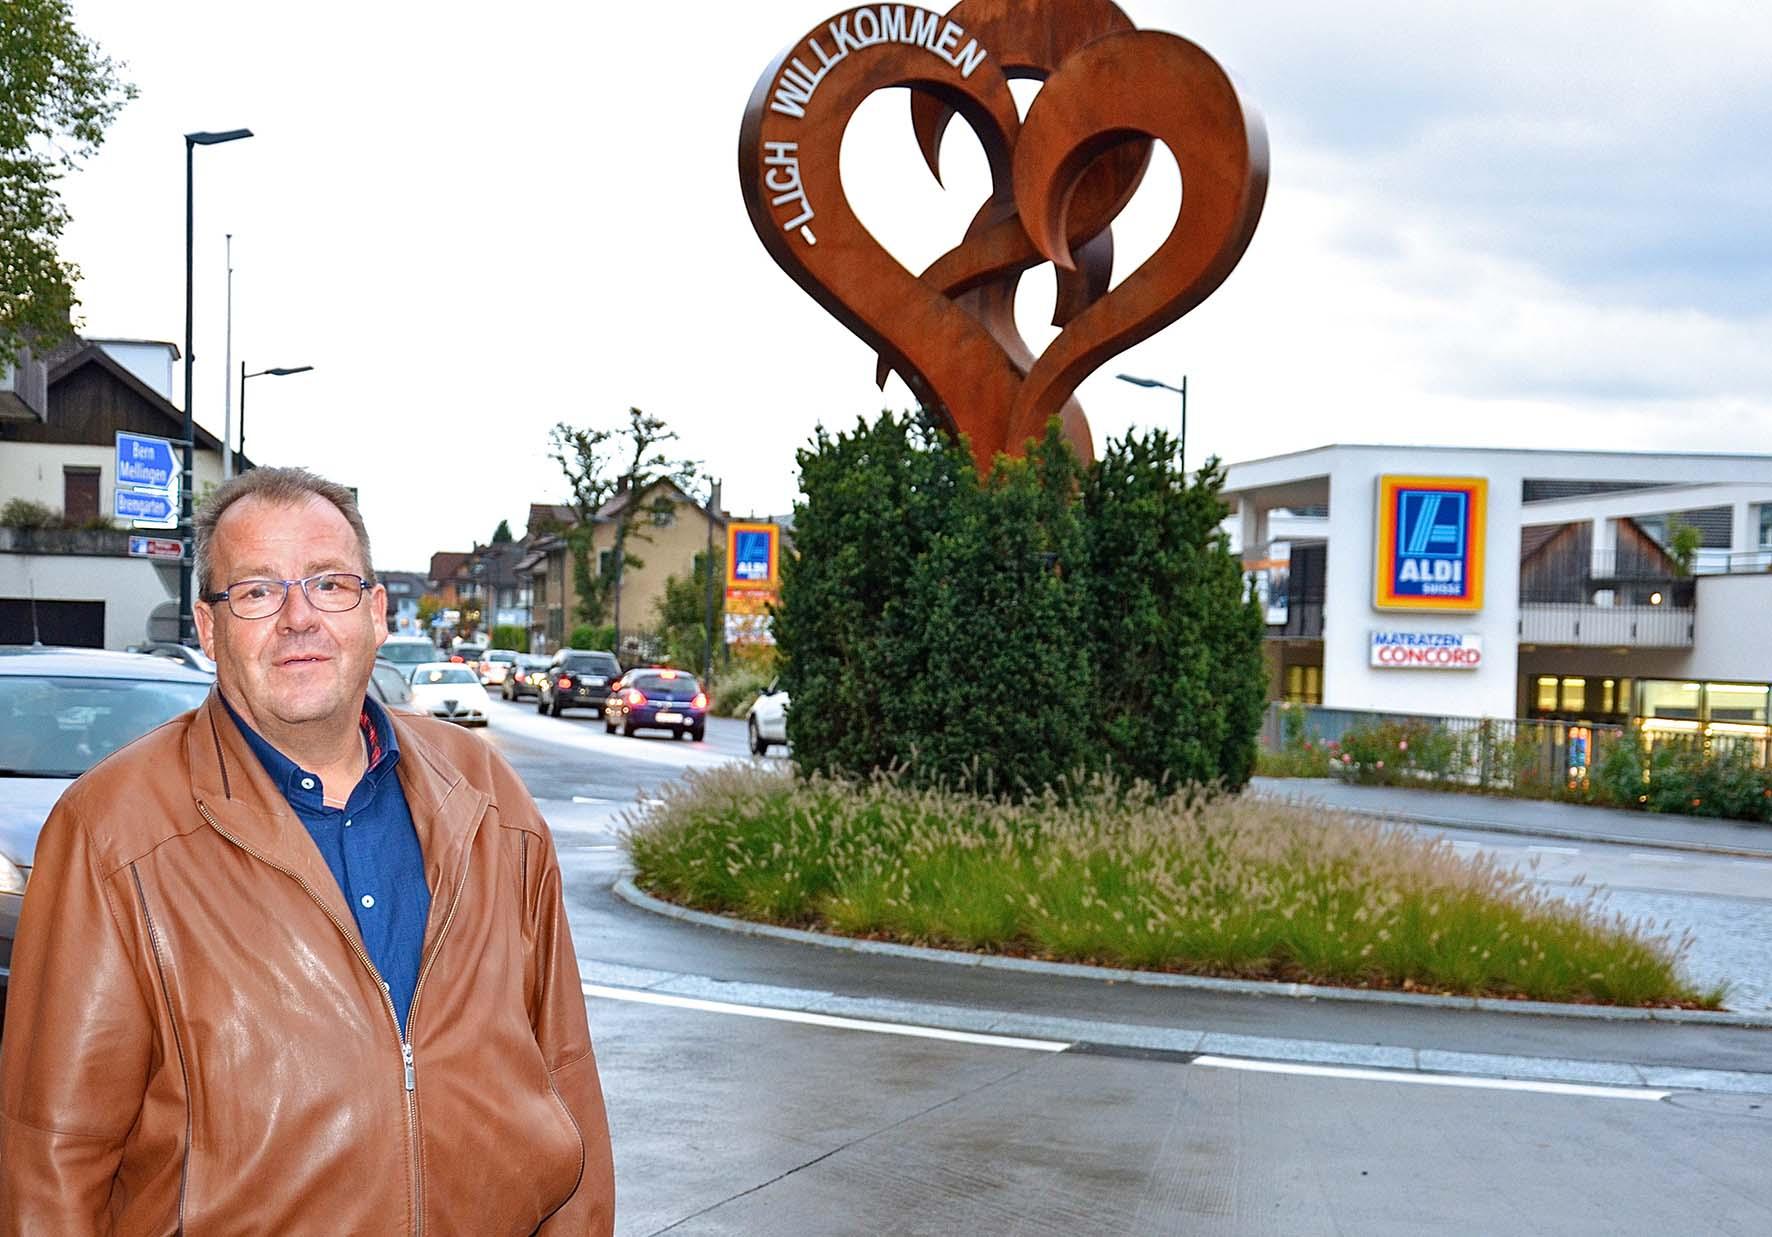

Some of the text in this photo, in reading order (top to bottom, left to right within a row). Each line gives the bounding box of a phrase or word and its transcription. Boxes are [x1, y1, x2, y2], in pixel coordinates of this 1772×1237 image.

[771, 5, 987, 118] WILLKOMMEN
[132, 441, 155, 459] Bern
[120, 460, 167, 485] Mellingen
[1399, 558, 1462, 582] ALDI
[1422, 583, 1461, 594] SUISSE
[1375, 632, 1462, 646] MATRATZEN
[1379, 646, 1480, 664] CONCORD
